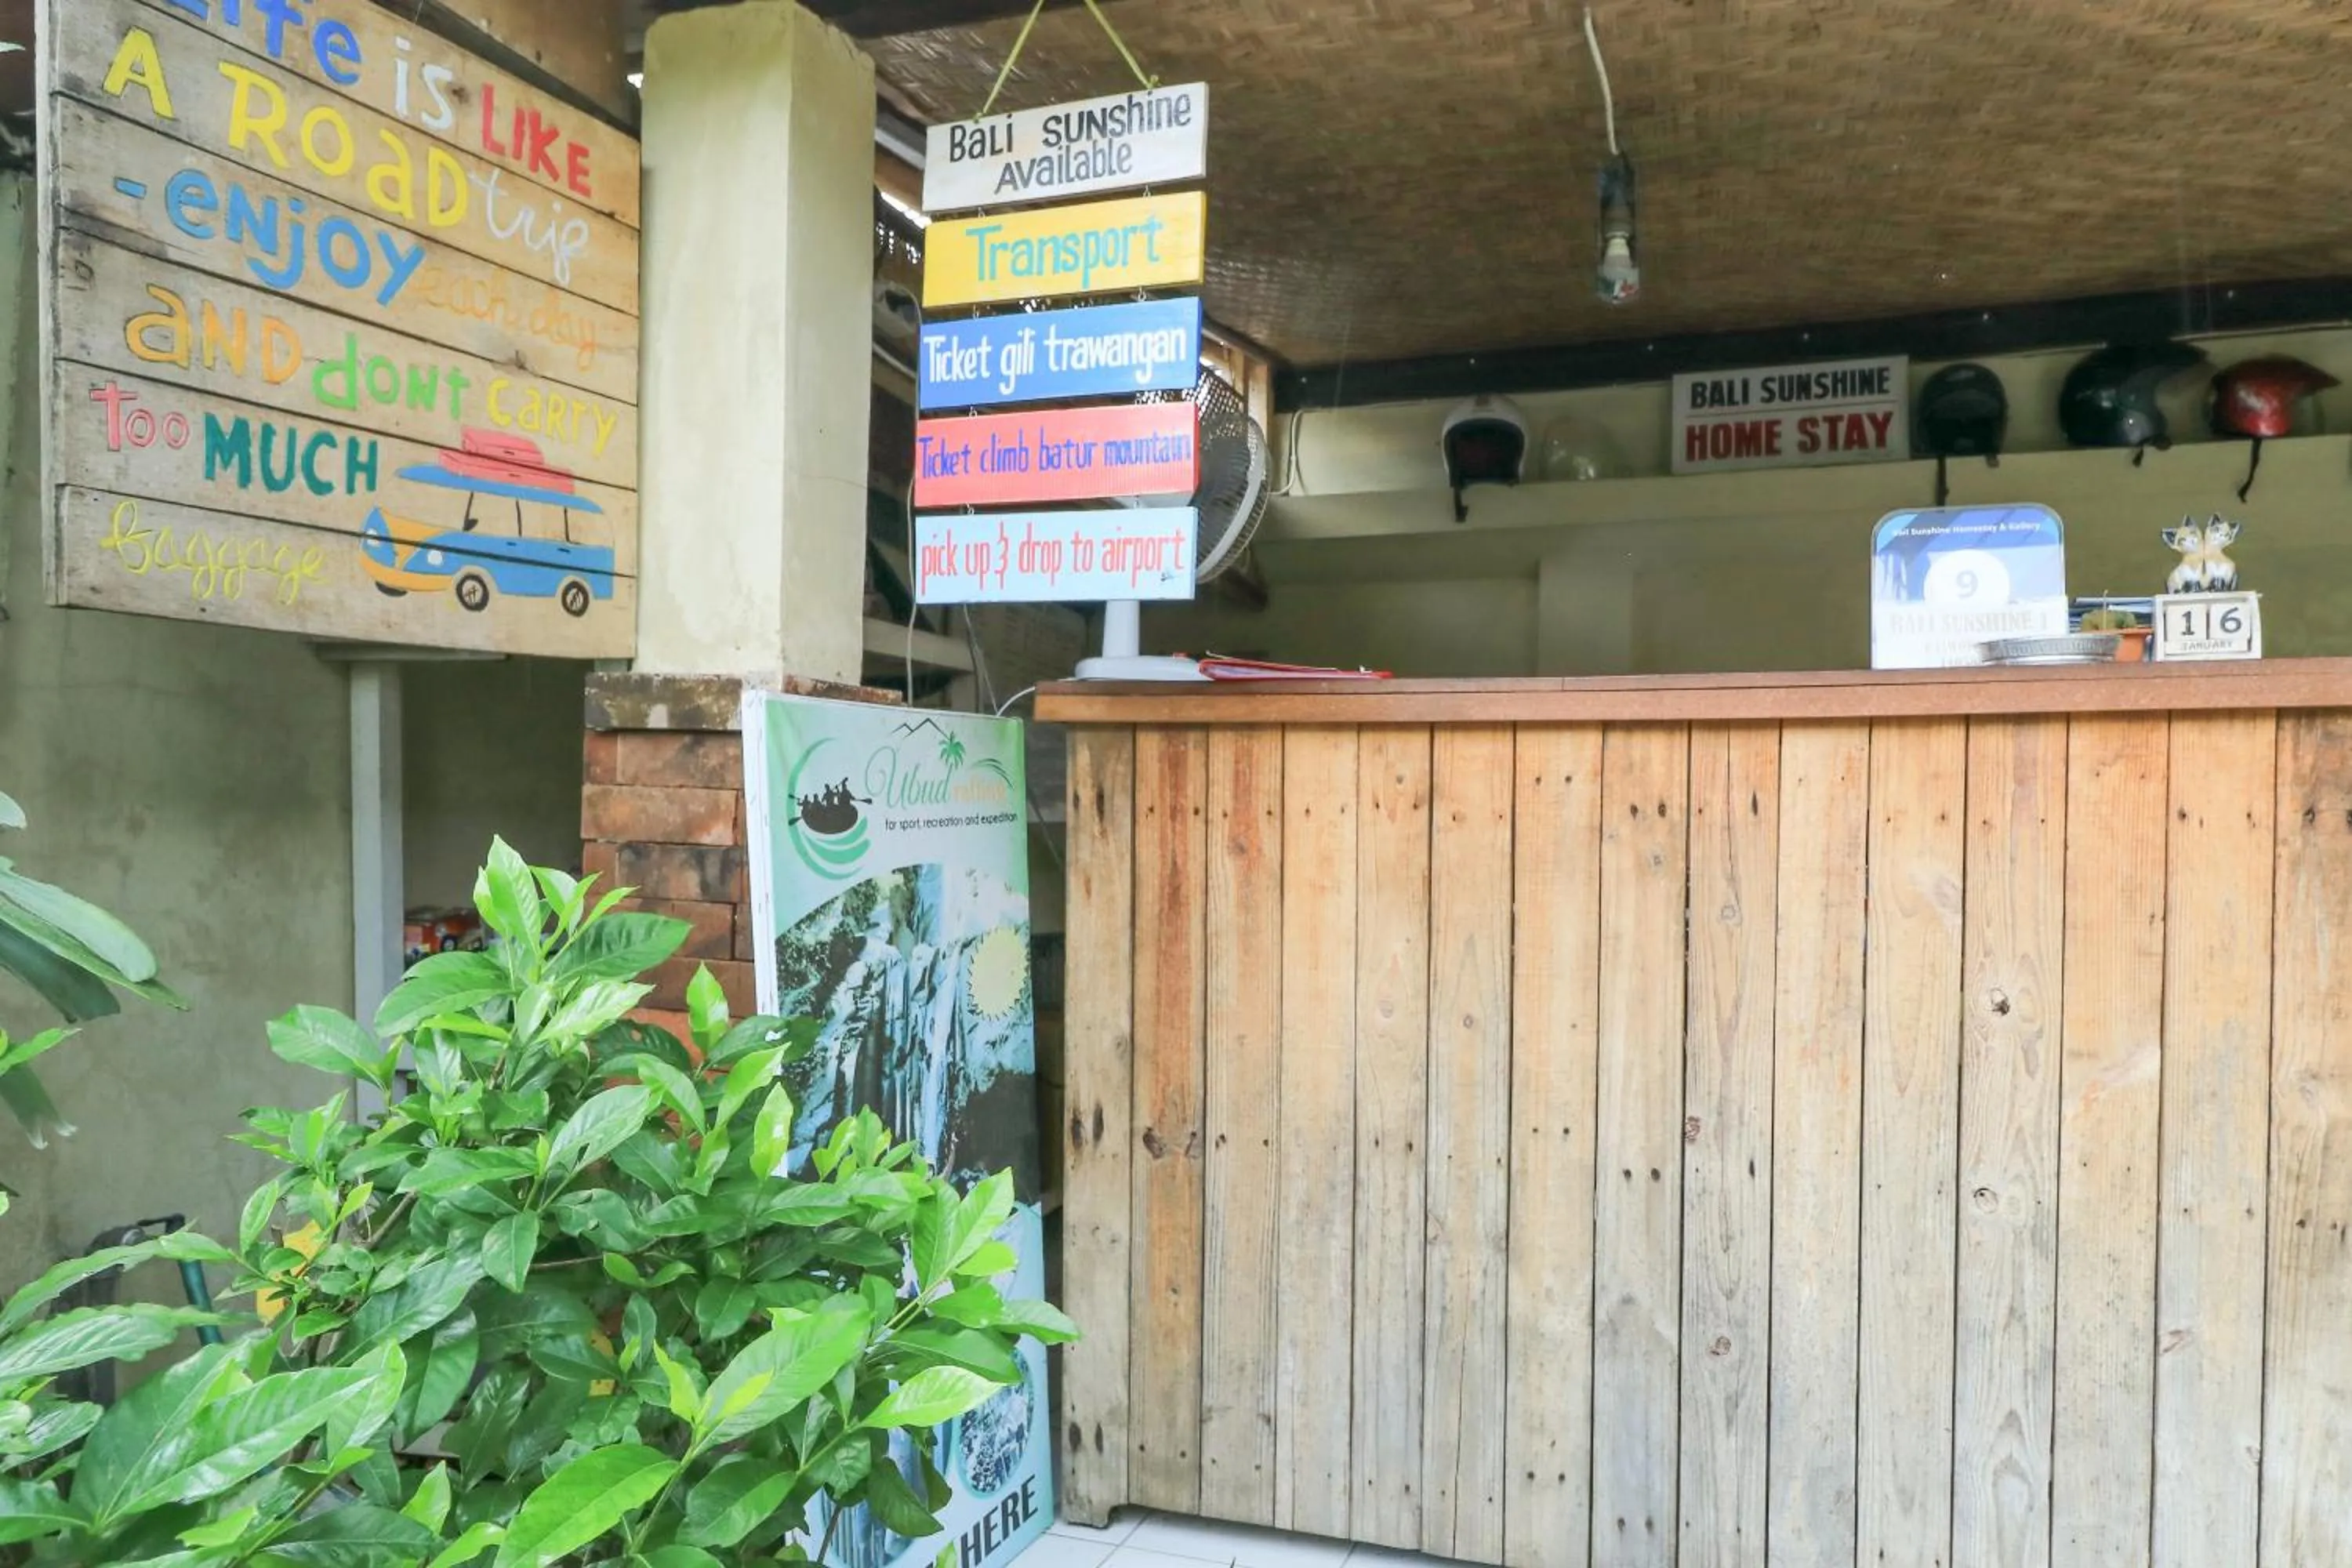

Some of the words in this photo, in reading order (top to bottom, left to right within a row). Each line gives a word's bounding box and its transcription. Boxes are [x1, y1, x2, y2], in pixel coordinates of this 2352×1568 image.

[102, 26, 174, 119] A
[468, 169, 590, 287] trip
[480, 83, 593, 198] LIKE
[965, 213, 1163, 290] Transport
[923, 334, 992, 383] Ticket
[1000, 326, 1036, 395] gili
[1044, 324, 1186, 384] trawangan
[1690, 378, 1749, 409] BALI
[1761, 366, 1890, 405] SUNSHINE
[203, 412, 378, 496] MUCH
[918, 436, 972, 480] Ticket
[980, 427, 1029, 474] climb
[1038, 426, 1098, 471] batur
[1104, 430, 1192, 467] mountain
[1686, 419, 1782, 463] HOME
[1796, 411, 1893, 455] STAY
[920, 528, 957, 596] pick
[964, 541, 990, 590] up
[1019, 521, 1062, 587] drop
[1070, 531, 1094, 574] to
[1101, 526, 1186, 589] airport
[1911, 525, 1951, 536] Sunshine
[1954, 569, 1979, 599] 9
[866, 745, 953, 810] Ubud
[885, 818, 897, 831] for
[923, 815, 963, 829] recreation
[964, 812, 979, 826] and
[981, 811, 1018, 825] expedition
[960, 1473, 1038, 1568] HERE
